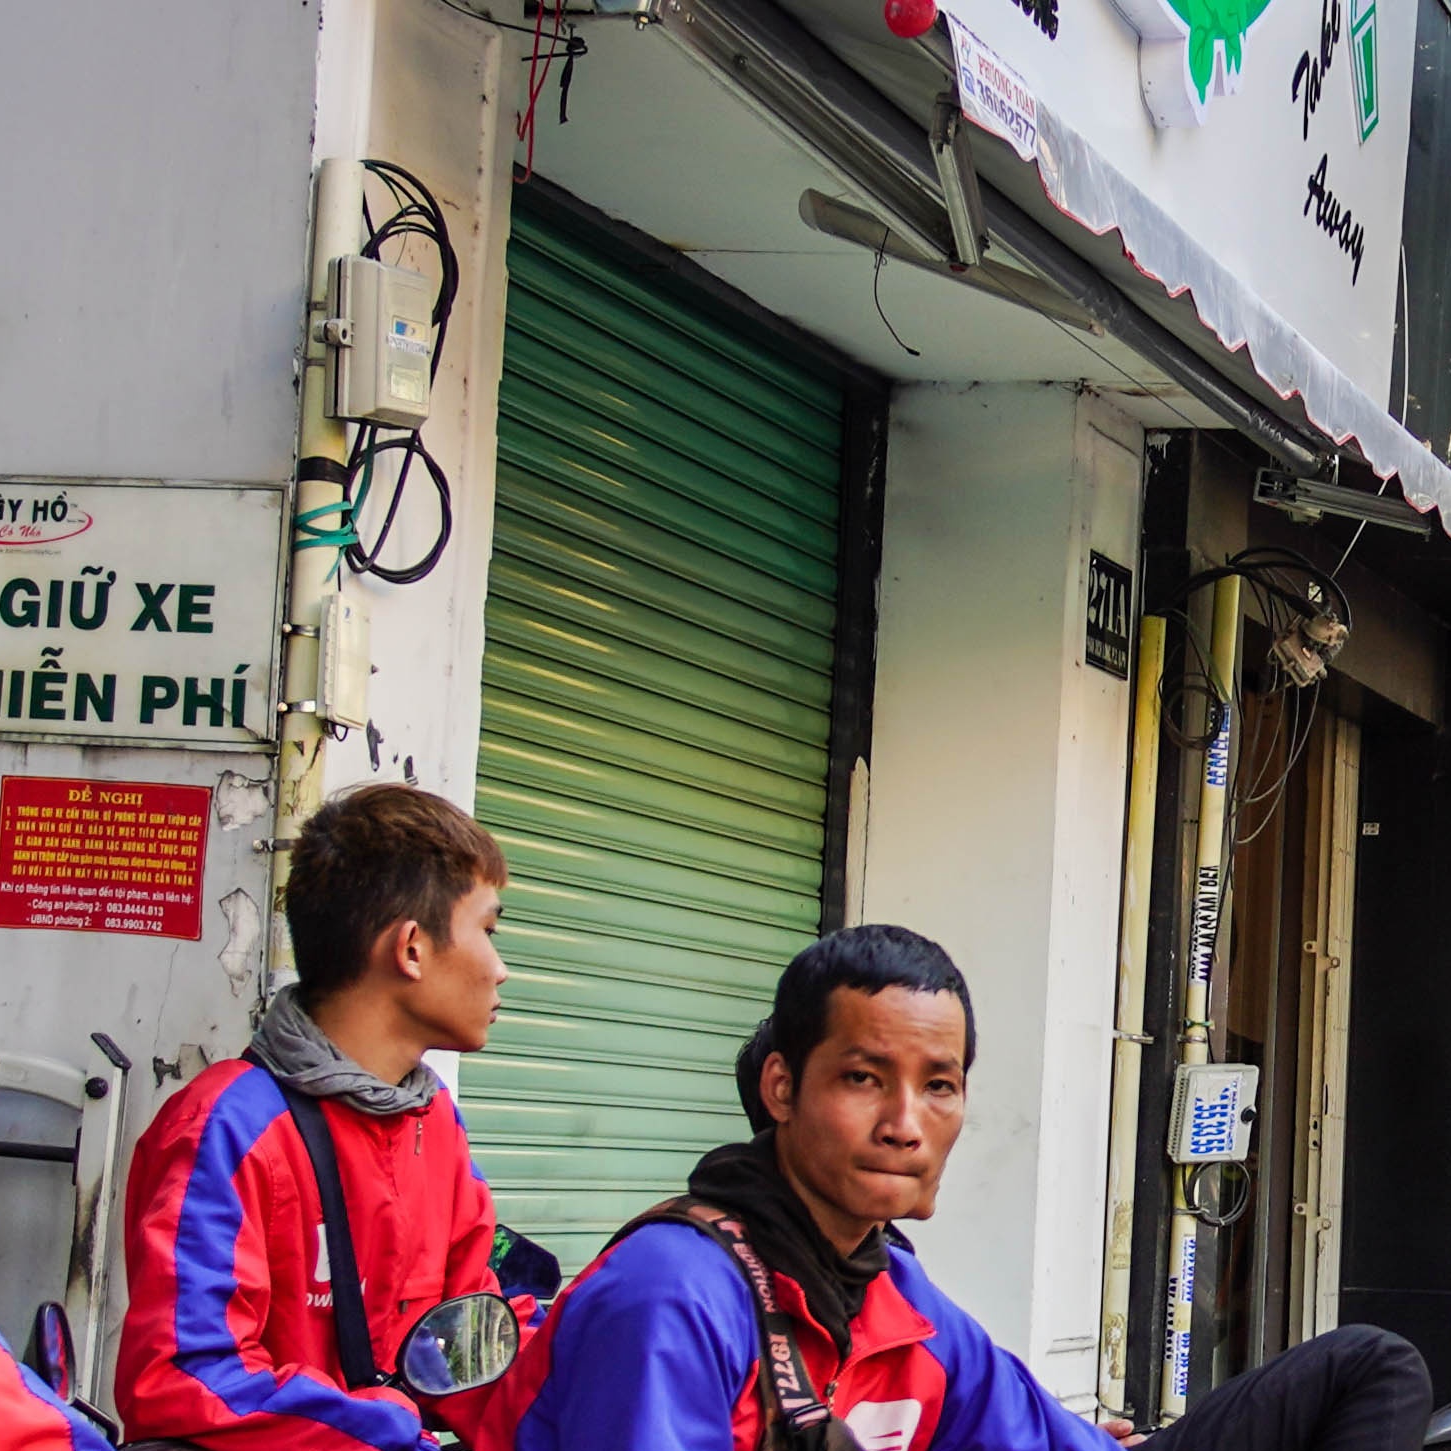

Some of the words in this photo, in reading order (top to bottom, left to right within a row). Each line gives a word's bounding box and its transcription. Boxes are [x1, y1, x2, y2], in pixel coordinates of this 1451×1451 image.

[1303, 153, 1365, 286] Away
[32, 491, 68, 524] HỒ
[0, 566, 116, 630] GIỮ
[130, 583, 215, 633] XE
[140, 664, 251, 728] PHÍ
